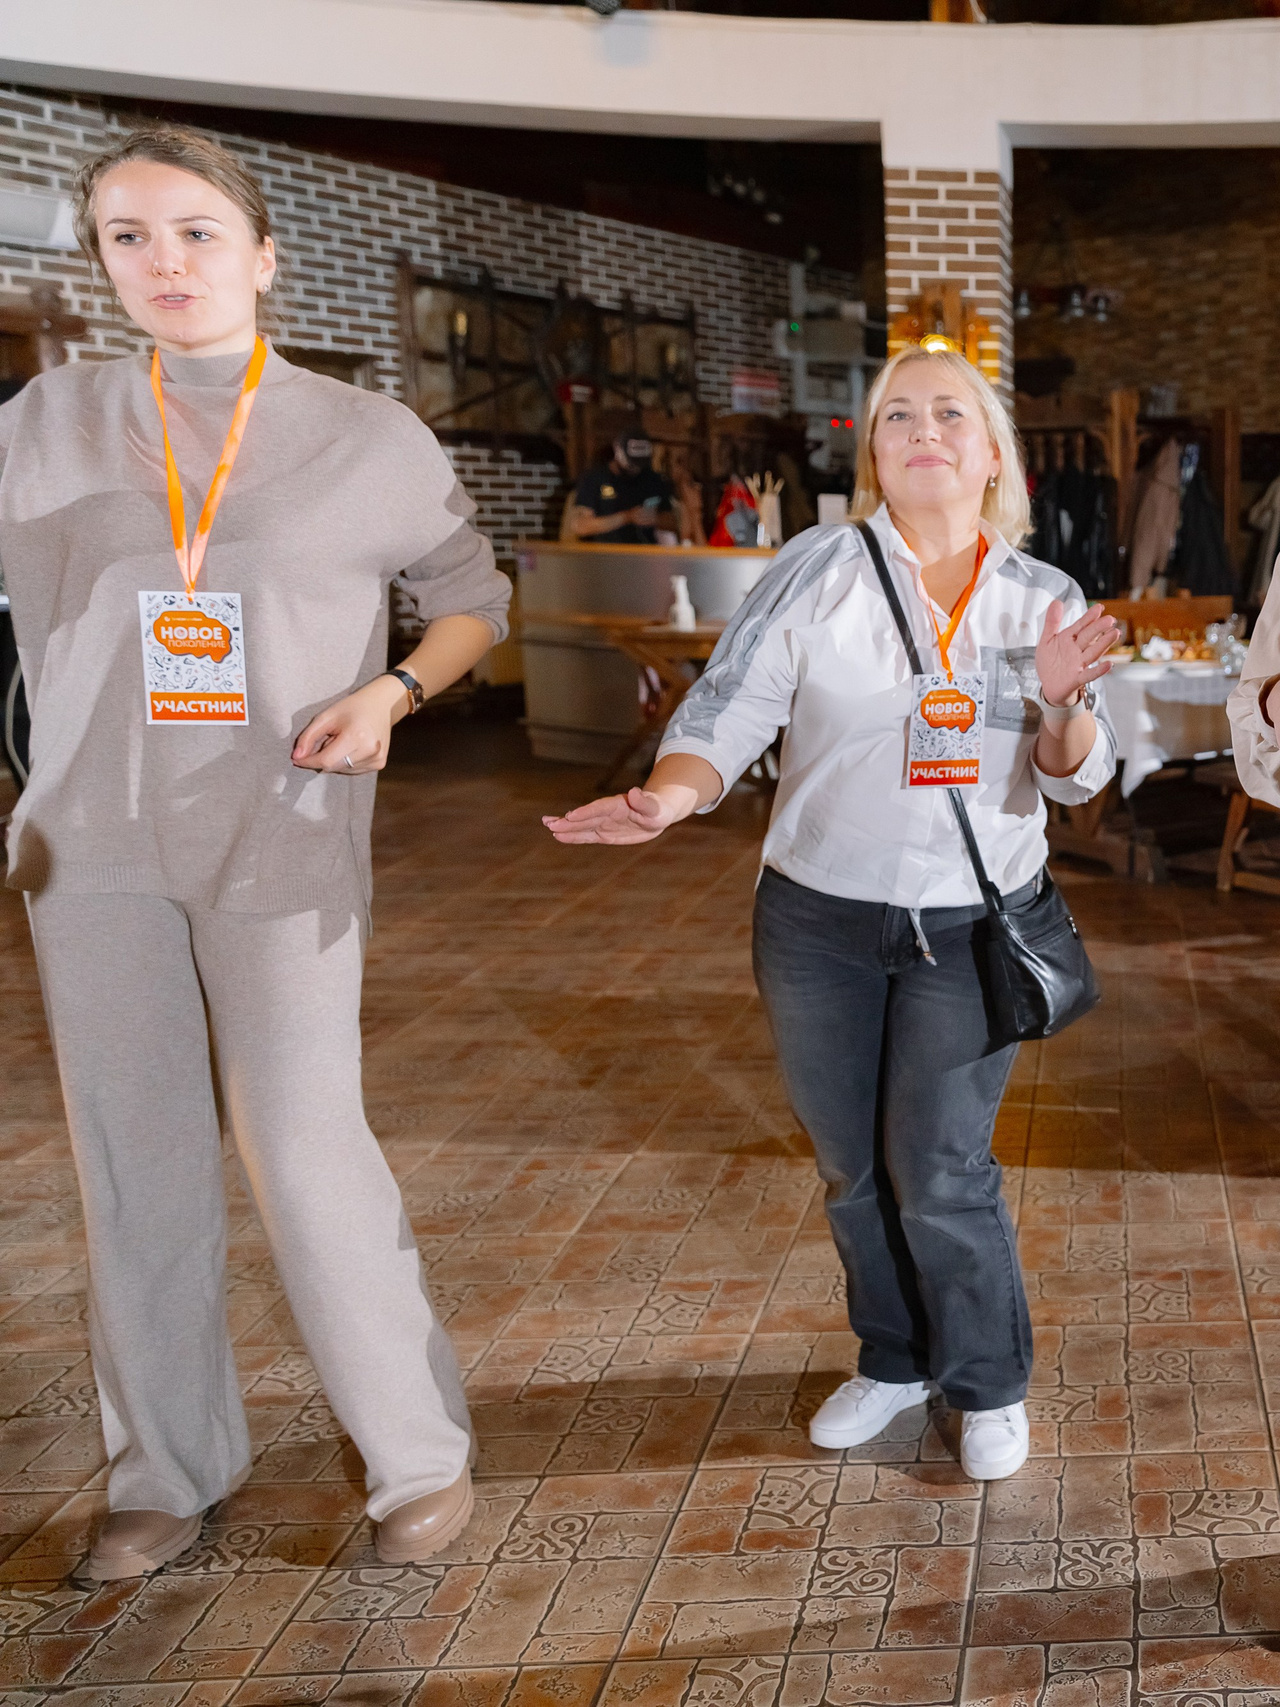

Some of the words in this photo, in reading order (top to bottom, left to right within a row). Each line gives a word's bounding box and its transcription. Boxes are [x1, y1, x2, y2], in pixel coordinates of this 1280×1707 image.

[160, 626, 223, 640] НОВОЕ
[168, 639, 226, 648] ПОКОЛЕНИЕ
[152, 700, 244, 713] УЧАСТНИК
[925, 702, 970, 715] НОВОЕ
[911, 766, 978, 779] УЧАСТНИК
